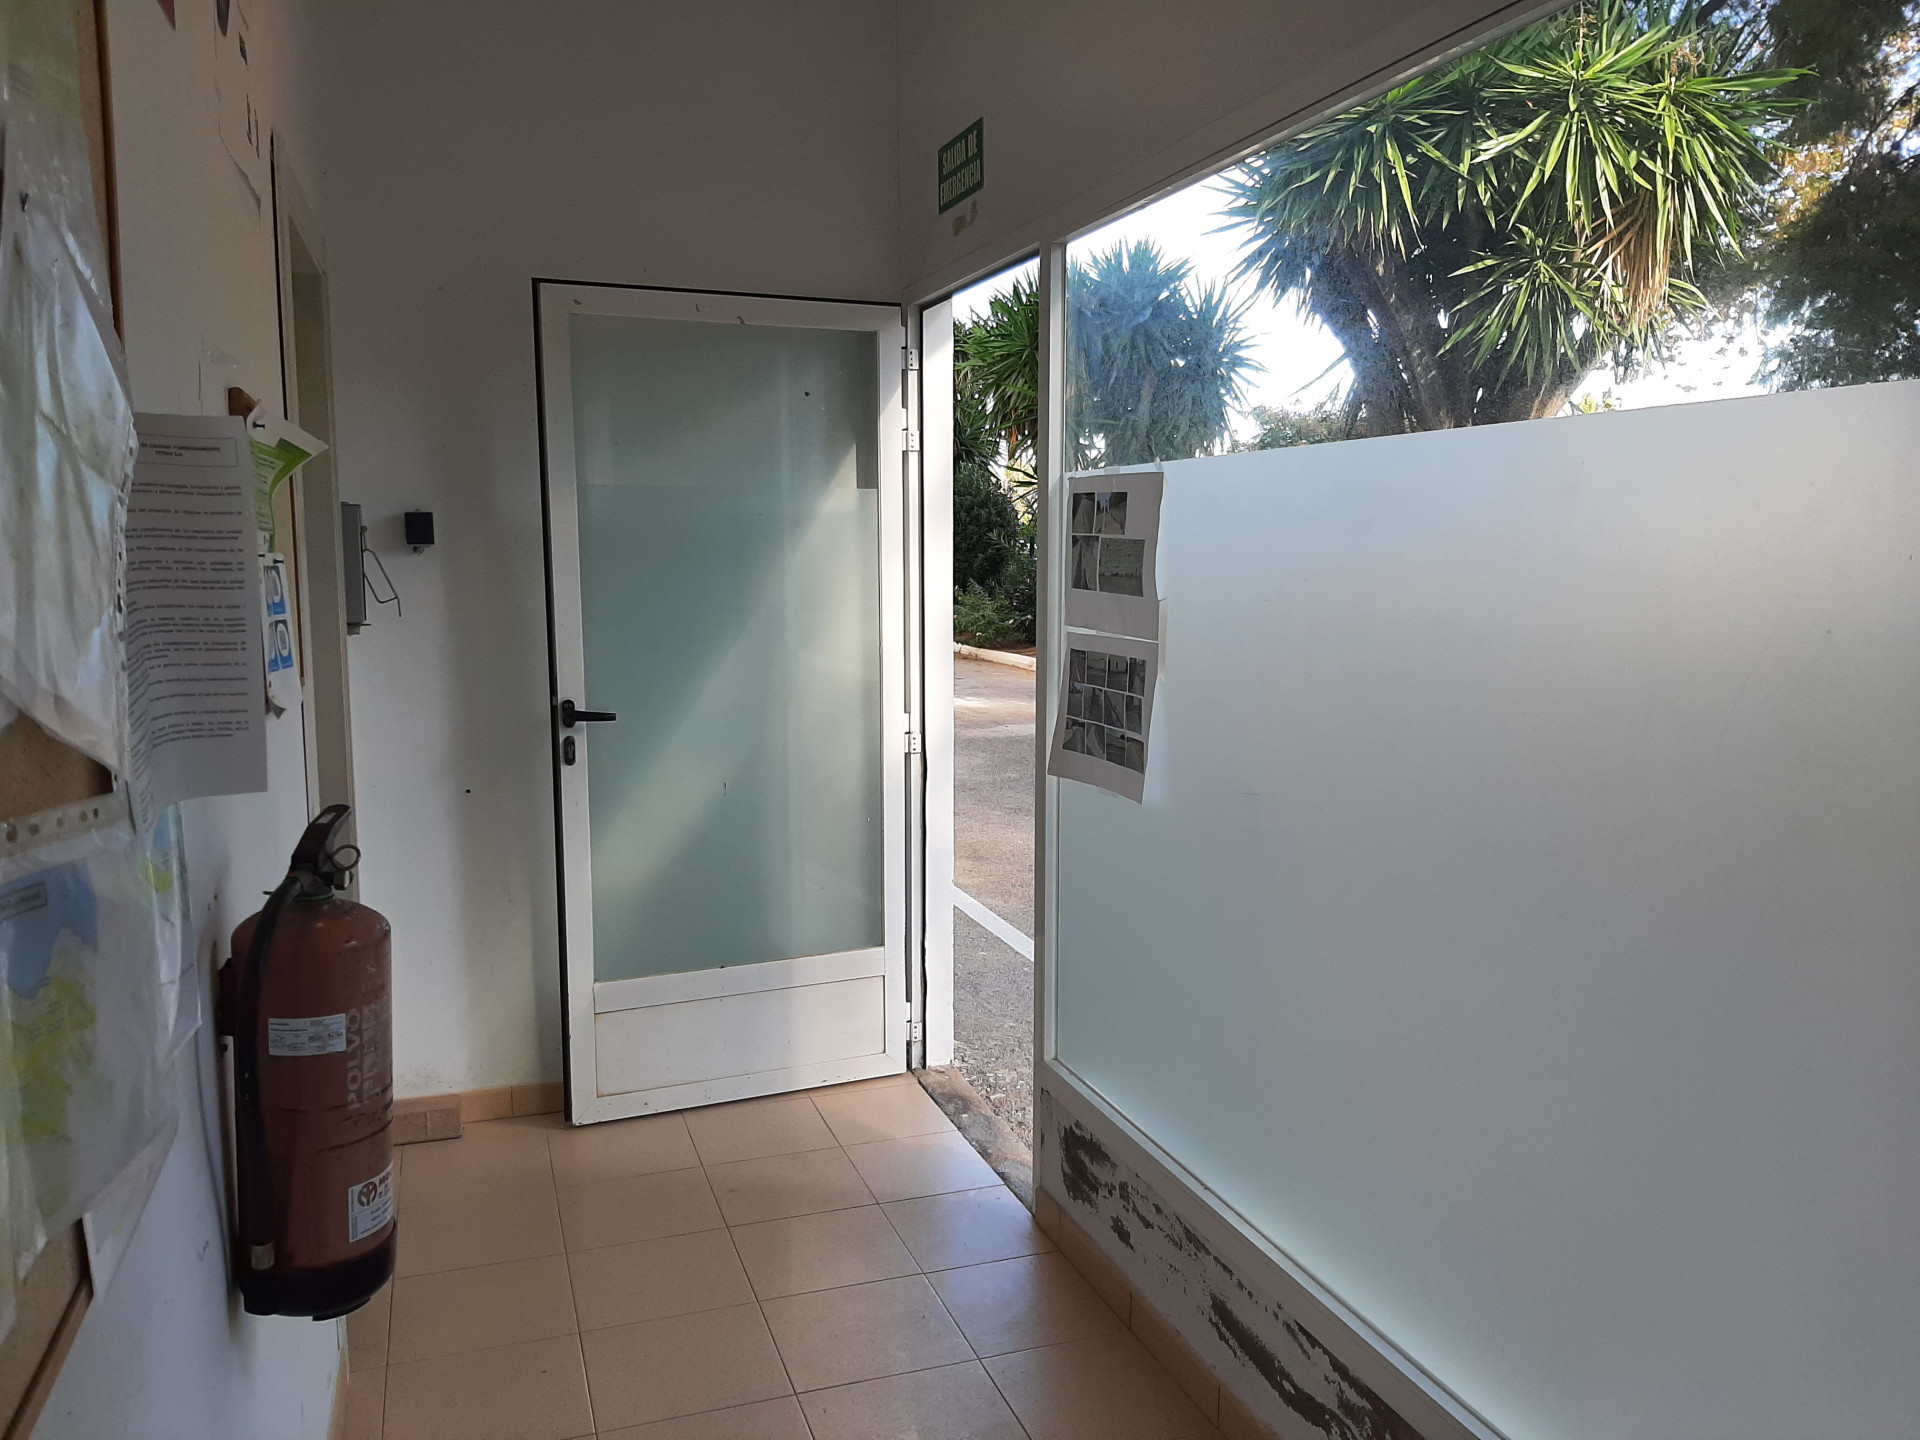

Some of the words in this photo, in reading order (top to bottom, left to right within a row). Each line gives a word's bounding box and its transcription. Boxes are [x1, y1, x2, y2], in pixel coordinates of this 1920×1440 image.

[942, 138, 967, 176] SALIDA
[967, 129, 978, 158] DE
[940, 158, 981, 207] EMERGENCIA
[347, 1008, 362, 1111] POLVO
